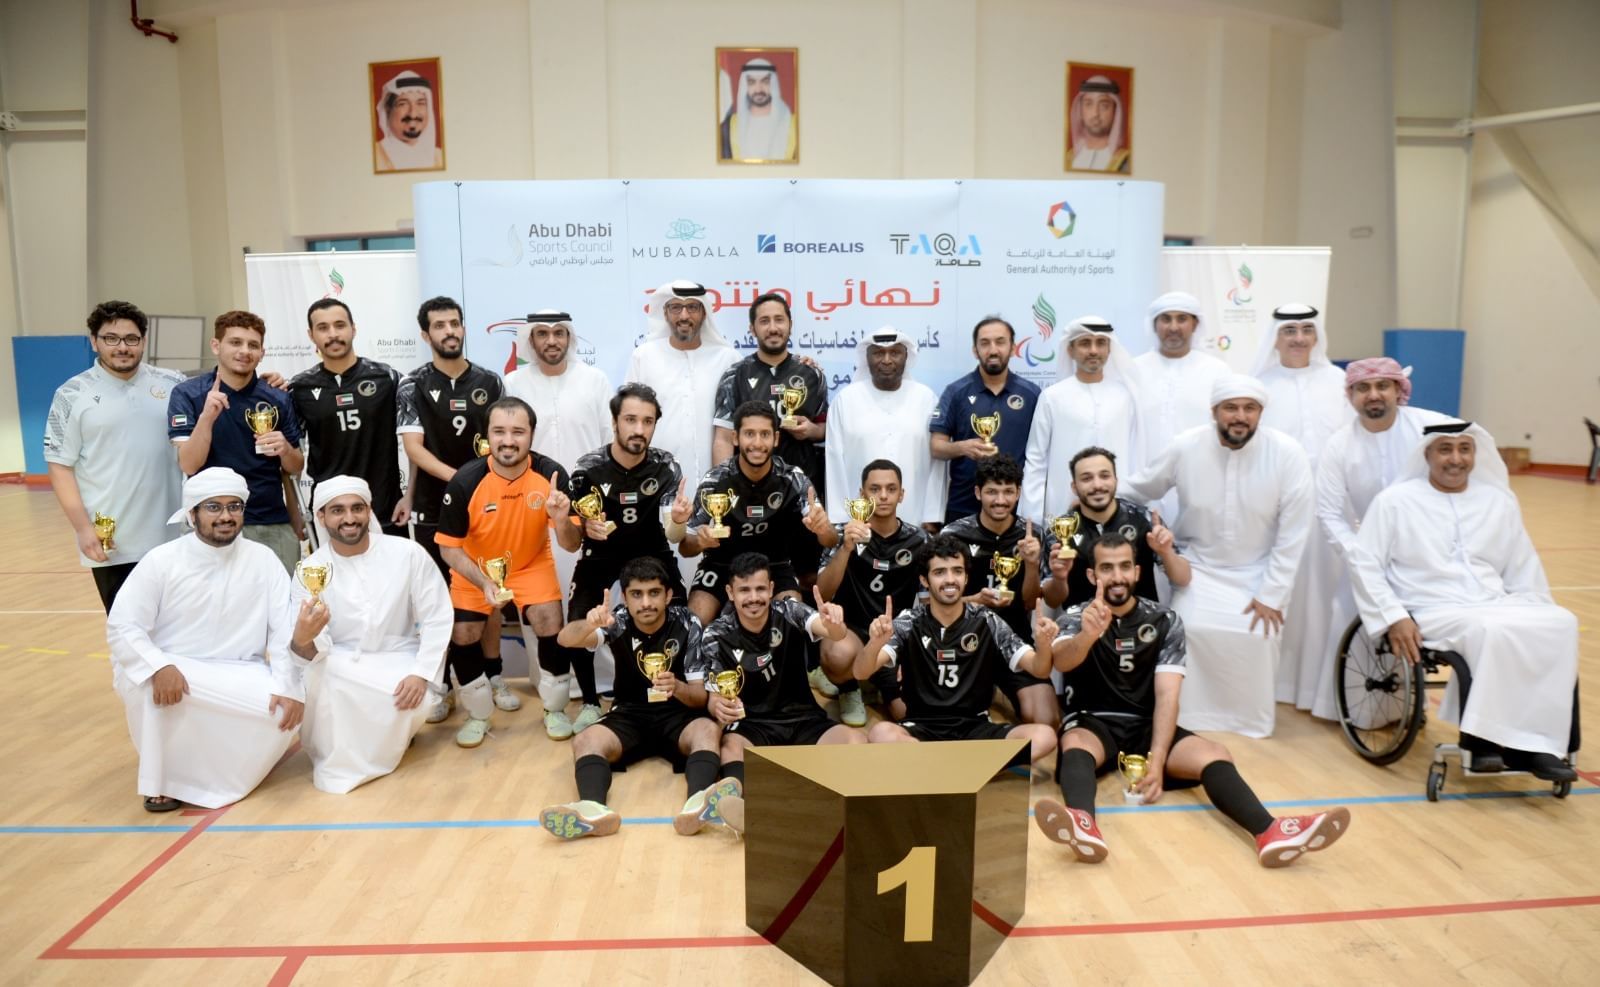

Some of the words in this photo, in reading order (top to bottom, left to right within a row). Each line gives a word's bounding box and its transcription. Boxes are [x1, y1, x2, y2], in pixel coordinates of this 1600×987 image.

[528, 223, 560, 238] Abu
[565, 222, 612, 238] Dhabi
[528, 240, 568, 255] Sports
[570, 239, 613, 253] Council
[632, 246, 740, 258] MUBADALA
[783, 242, 865, 254] BOREALIS
[889, 232, 982, 257] TAQA
[589, 255, 614, 266] مجلس
[1006, 264, 1038, 275] General
[1040, 264, 1077, 276] Authority
[1078, 264, 1086, 275] of
[1087, 264, 1115, 276] Sports
[806, 278, 941, 321] نهائي
[377, 338, 392, 346] Abu
[393, 338, 416, 346] Dhabi
[336, 409, 361, 432] 15
[452, 415, 467, 436] 9
[622, 507, 638, 524] 8
[741, 522, 769, 537] 20
[692, 569, 718, 588] 20
[869, 574, 885, 592] 6
[761, 661, 777, 683] 11
[1119, 654, 1135, 673] 5
[937, 664, 960, 688] 13
[877, 846, 937, 942] 1
